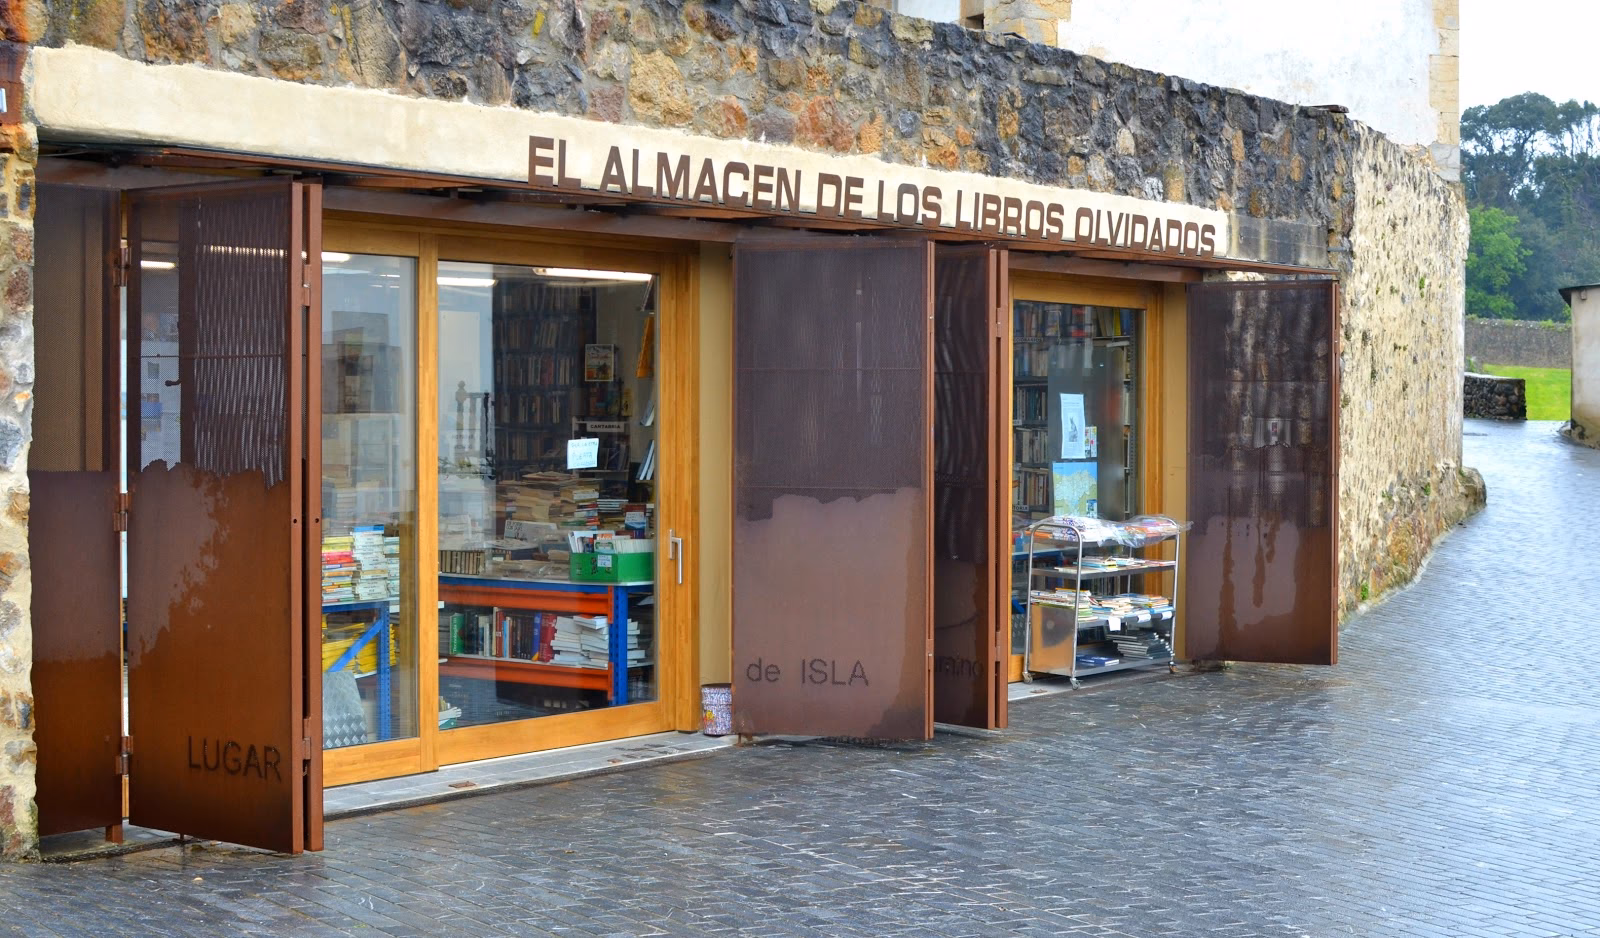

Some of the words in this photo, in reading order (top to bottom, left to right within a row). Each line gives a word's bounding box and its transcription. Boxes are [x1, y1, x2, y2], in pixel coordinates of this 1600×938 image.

[528, 135, 582, 190] EL
[600, 145, 802, 214] ALMACEN
[816, 172, 864, 220] DE
[877, 180, 942, 228] LOS
[955, 190, 1064, 242] LIBROS
[1075, 206, 1216, 257] OLVIDADOS
[746, 657, 781, 682] de
[801, 658, 869, 687] ISLA
[188, 736, 282, 782] LUGAR
